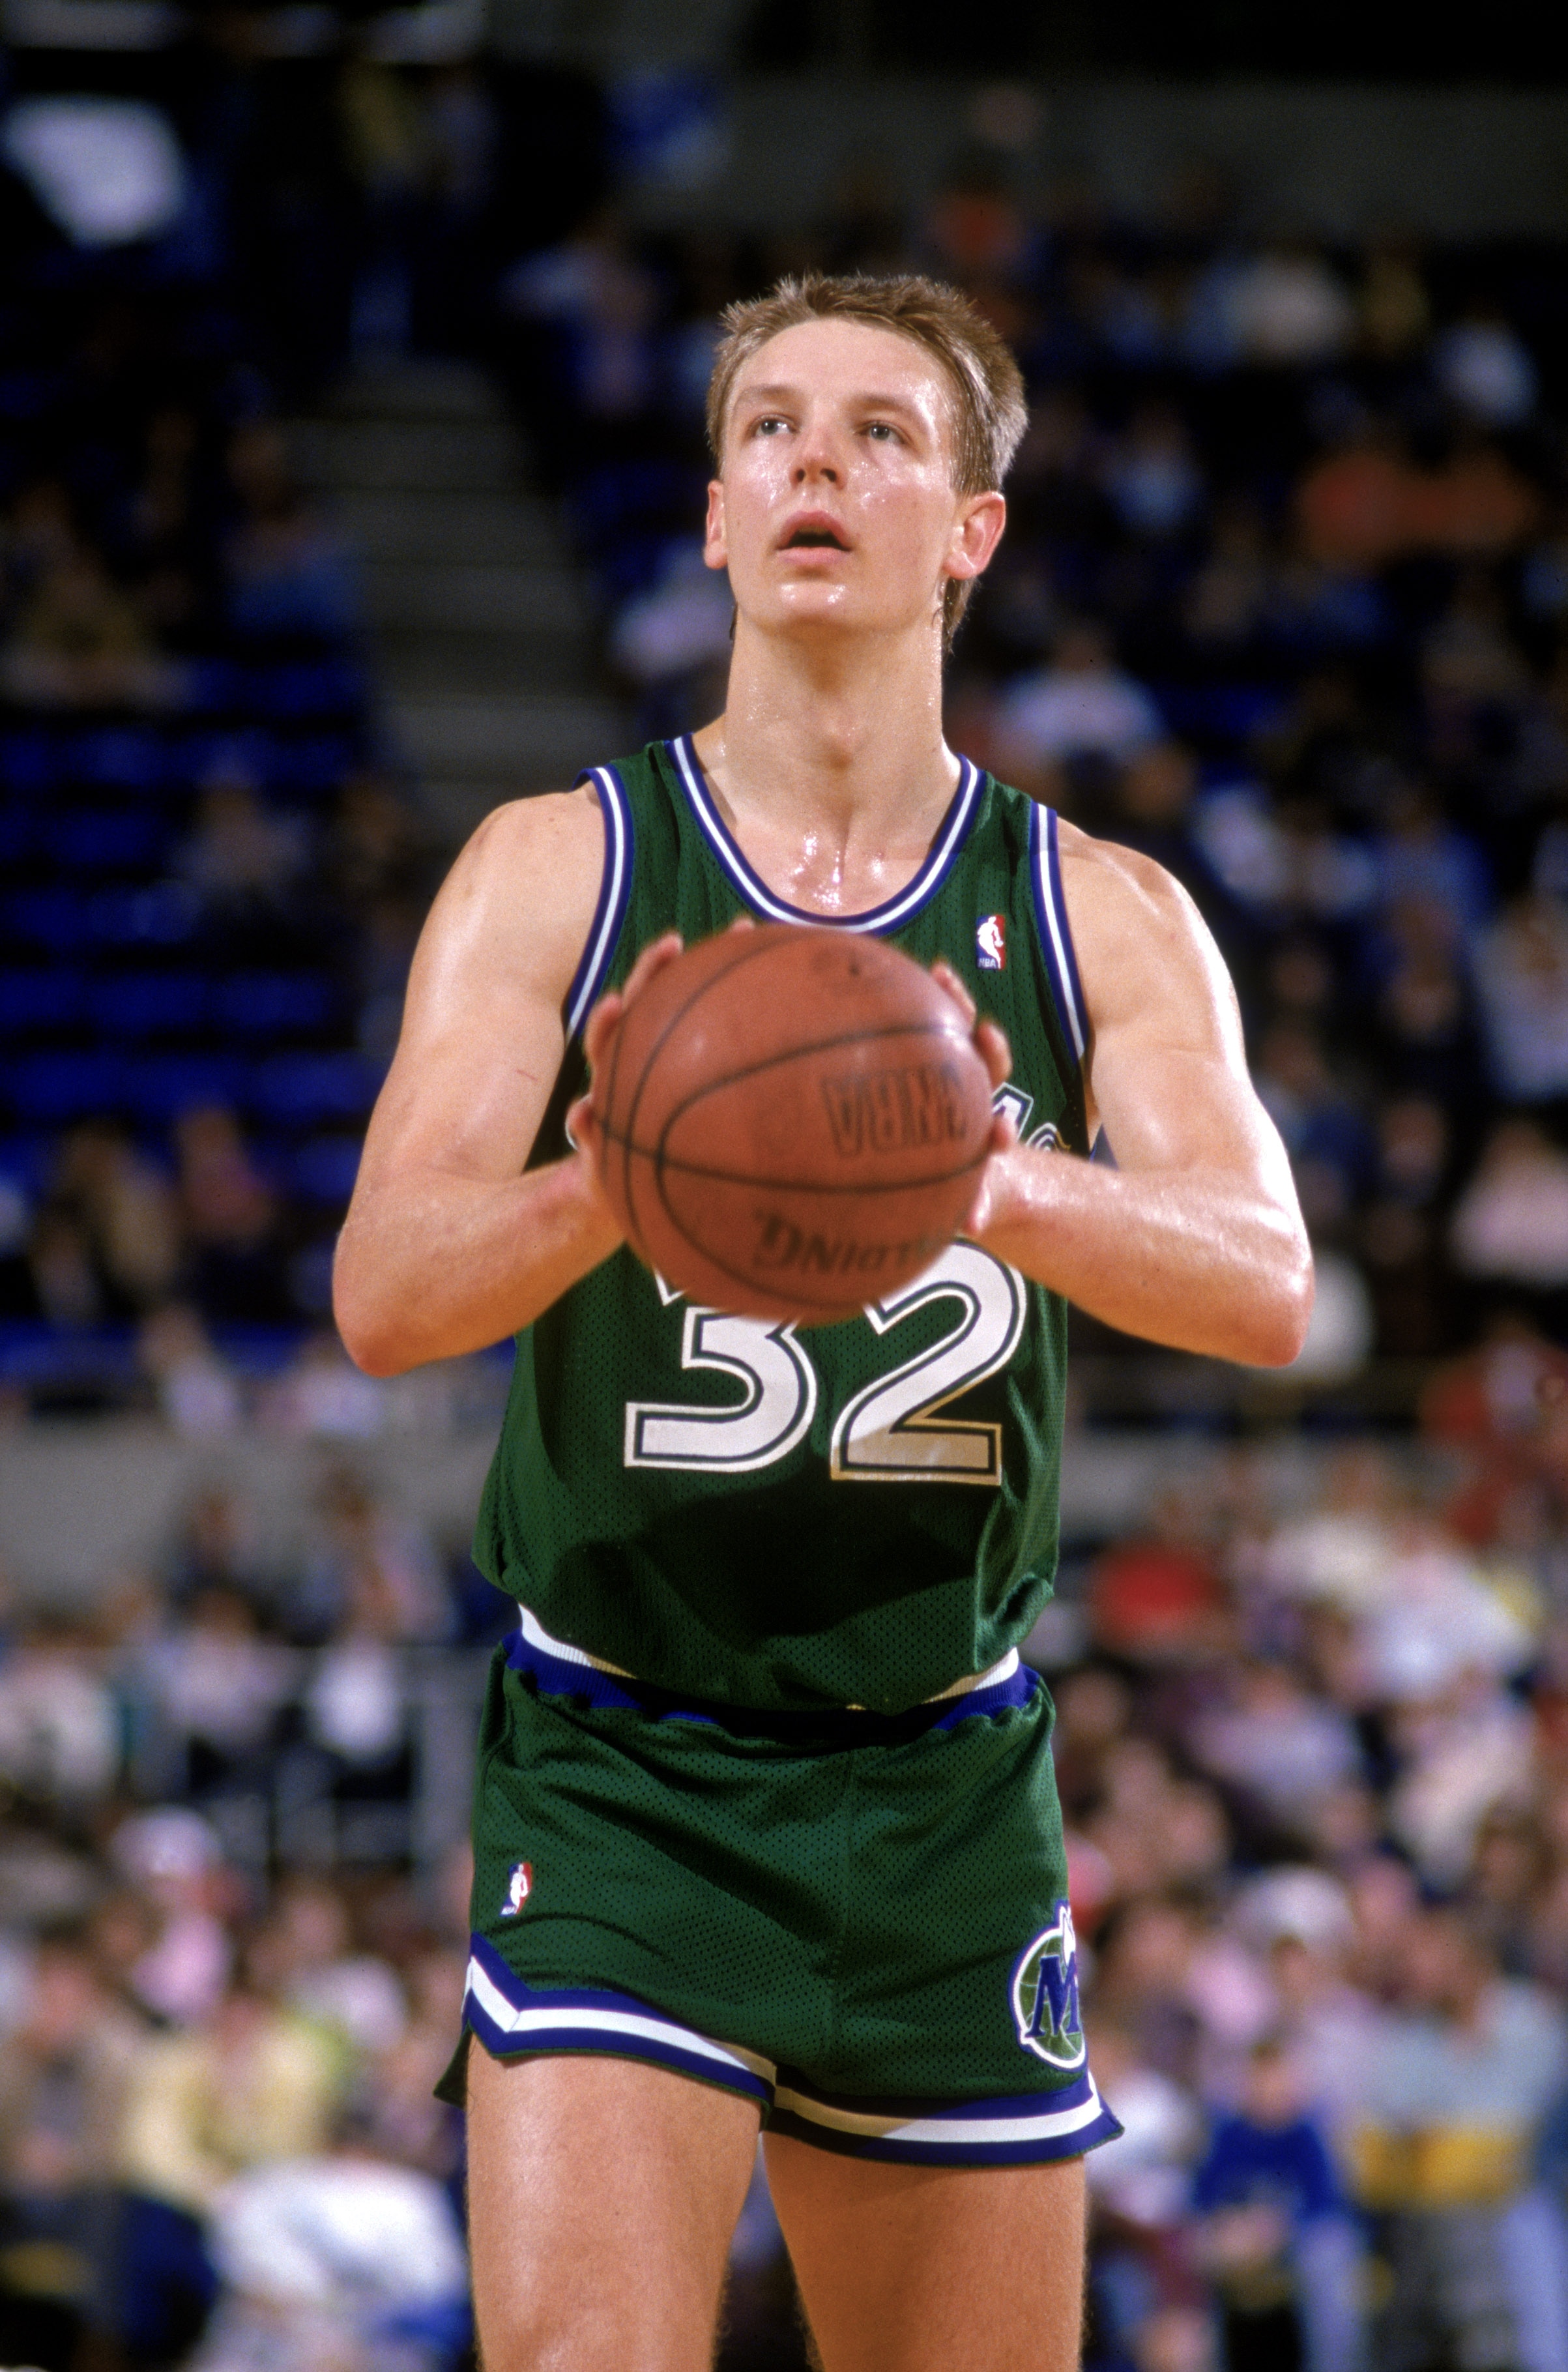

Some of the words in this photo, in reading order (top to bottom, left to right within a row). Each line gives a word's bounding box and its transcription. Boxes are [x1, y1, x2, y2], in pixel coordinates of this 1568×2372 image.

[978, 958, 996, 969] NBA
[624, 1236, 1027, 1486] 32
[1024, 1950, 1081, 2038] M
